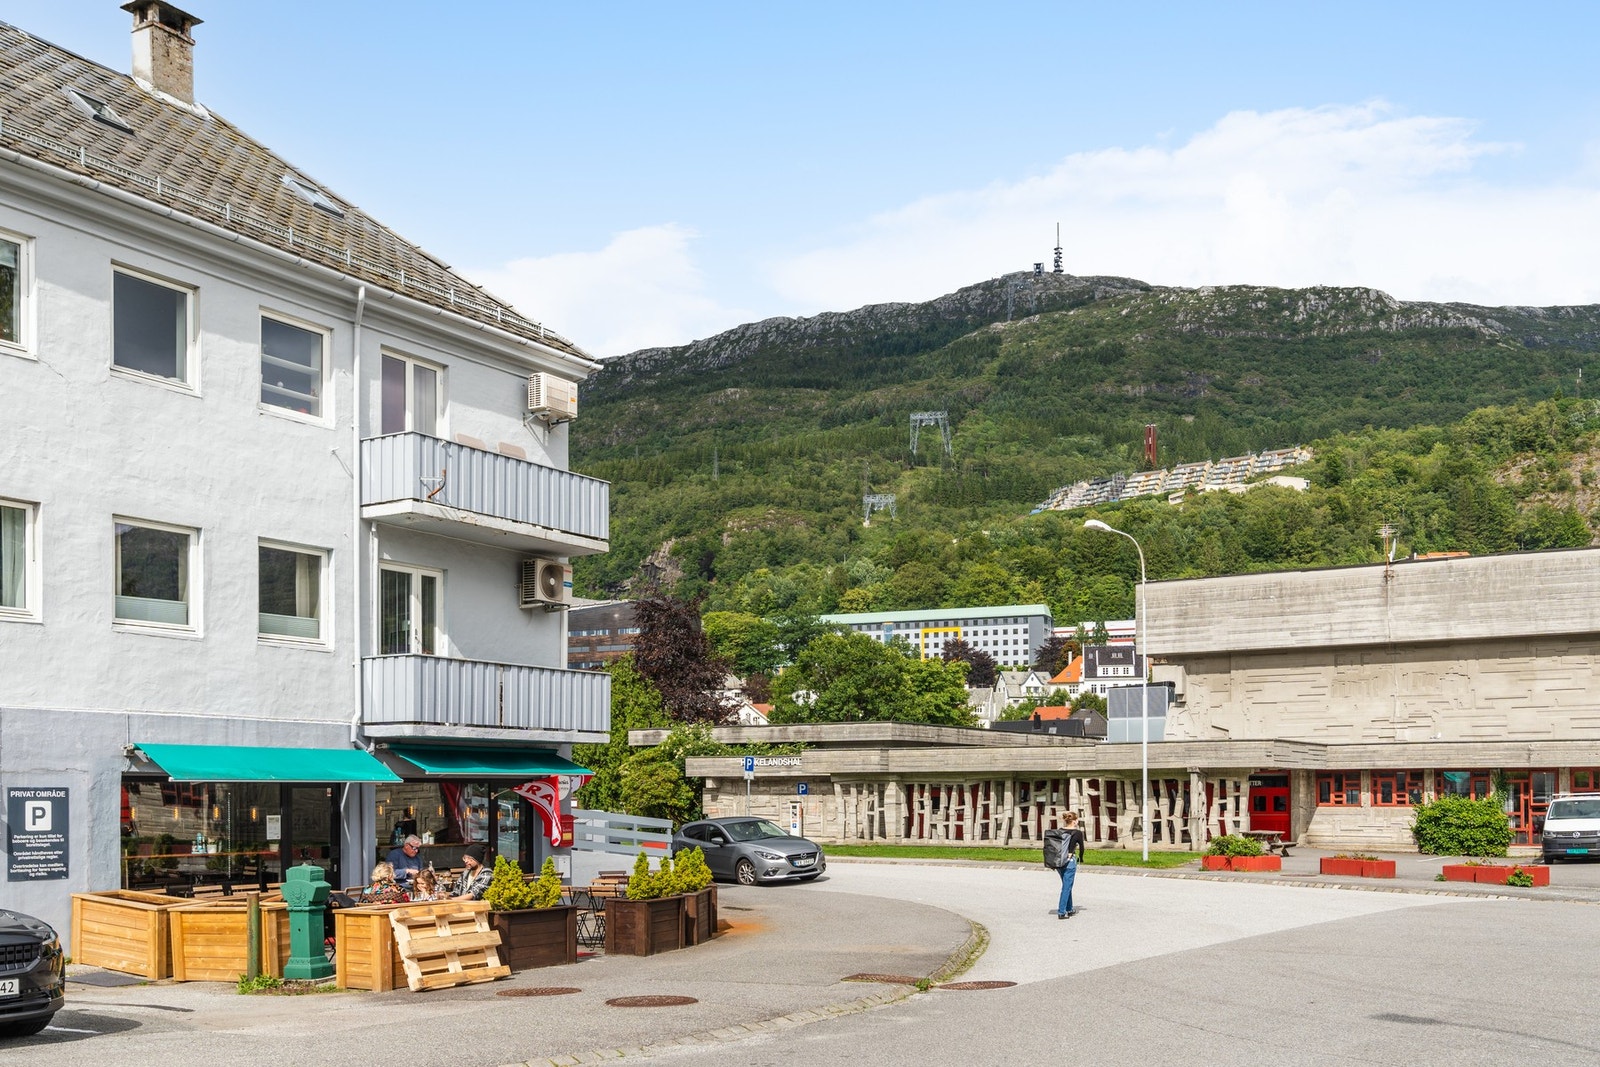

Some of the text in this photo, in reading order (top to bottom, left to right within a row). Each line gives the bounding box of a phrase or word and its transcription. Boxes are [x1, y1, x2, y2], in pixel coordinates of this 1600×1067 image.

[746, 758, 752, 770] P
[36, 790, 66, 798] OMRÅDE
[799, 784, 806, 794] P
[32, 806, 46, 826] P
